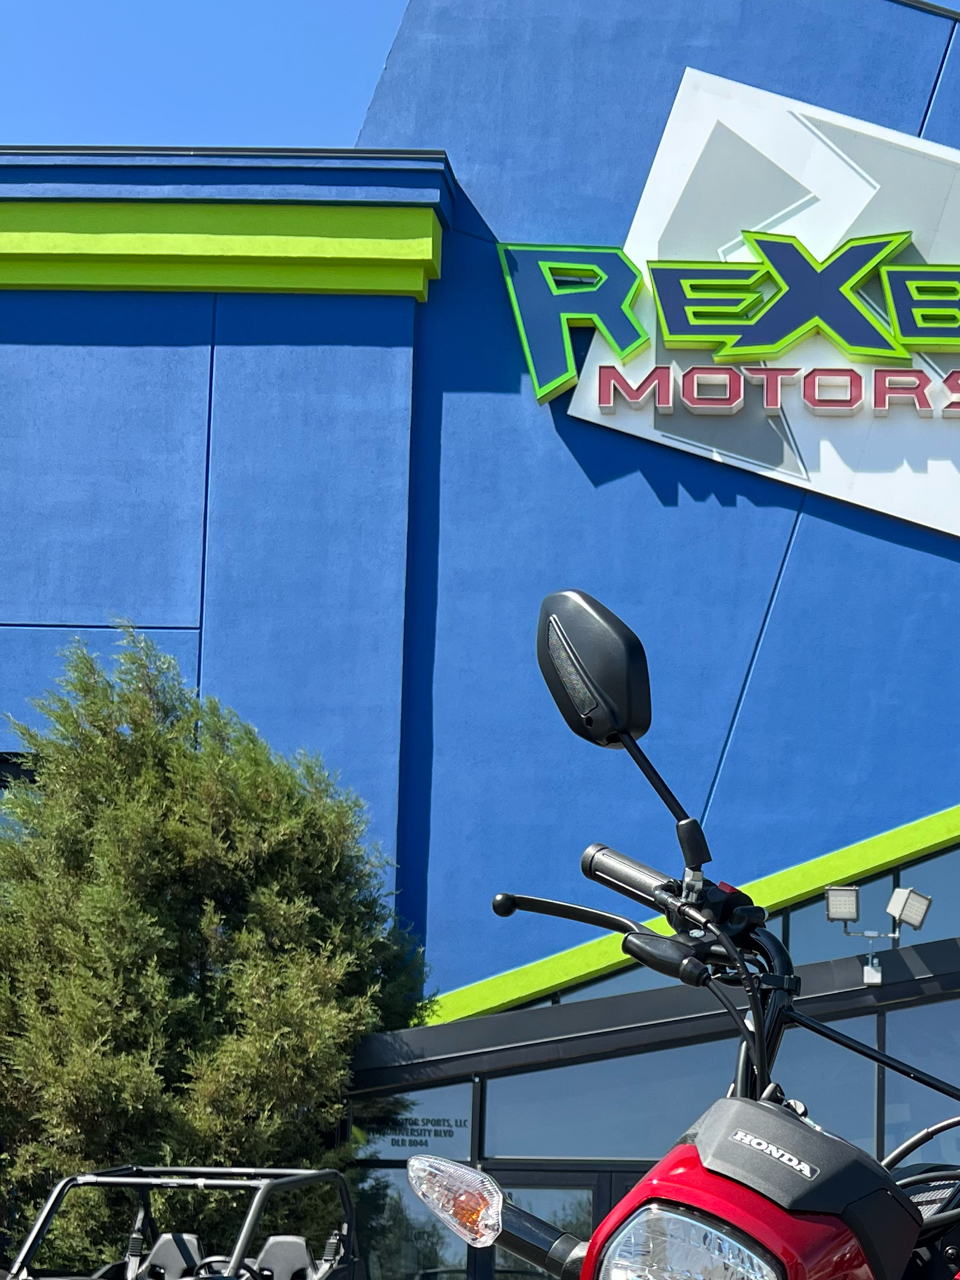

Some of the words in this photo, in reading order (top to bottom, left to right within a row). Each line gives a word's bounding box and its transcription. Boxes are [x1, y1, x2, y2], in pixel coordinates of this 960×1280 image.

[455, 1119, 469, 1129] LLC
[433, 1128, 454, 1138] BLVD
[391, 1138, 407, 1147] DLR
[732, 1130, 812, 1178] HONDA
